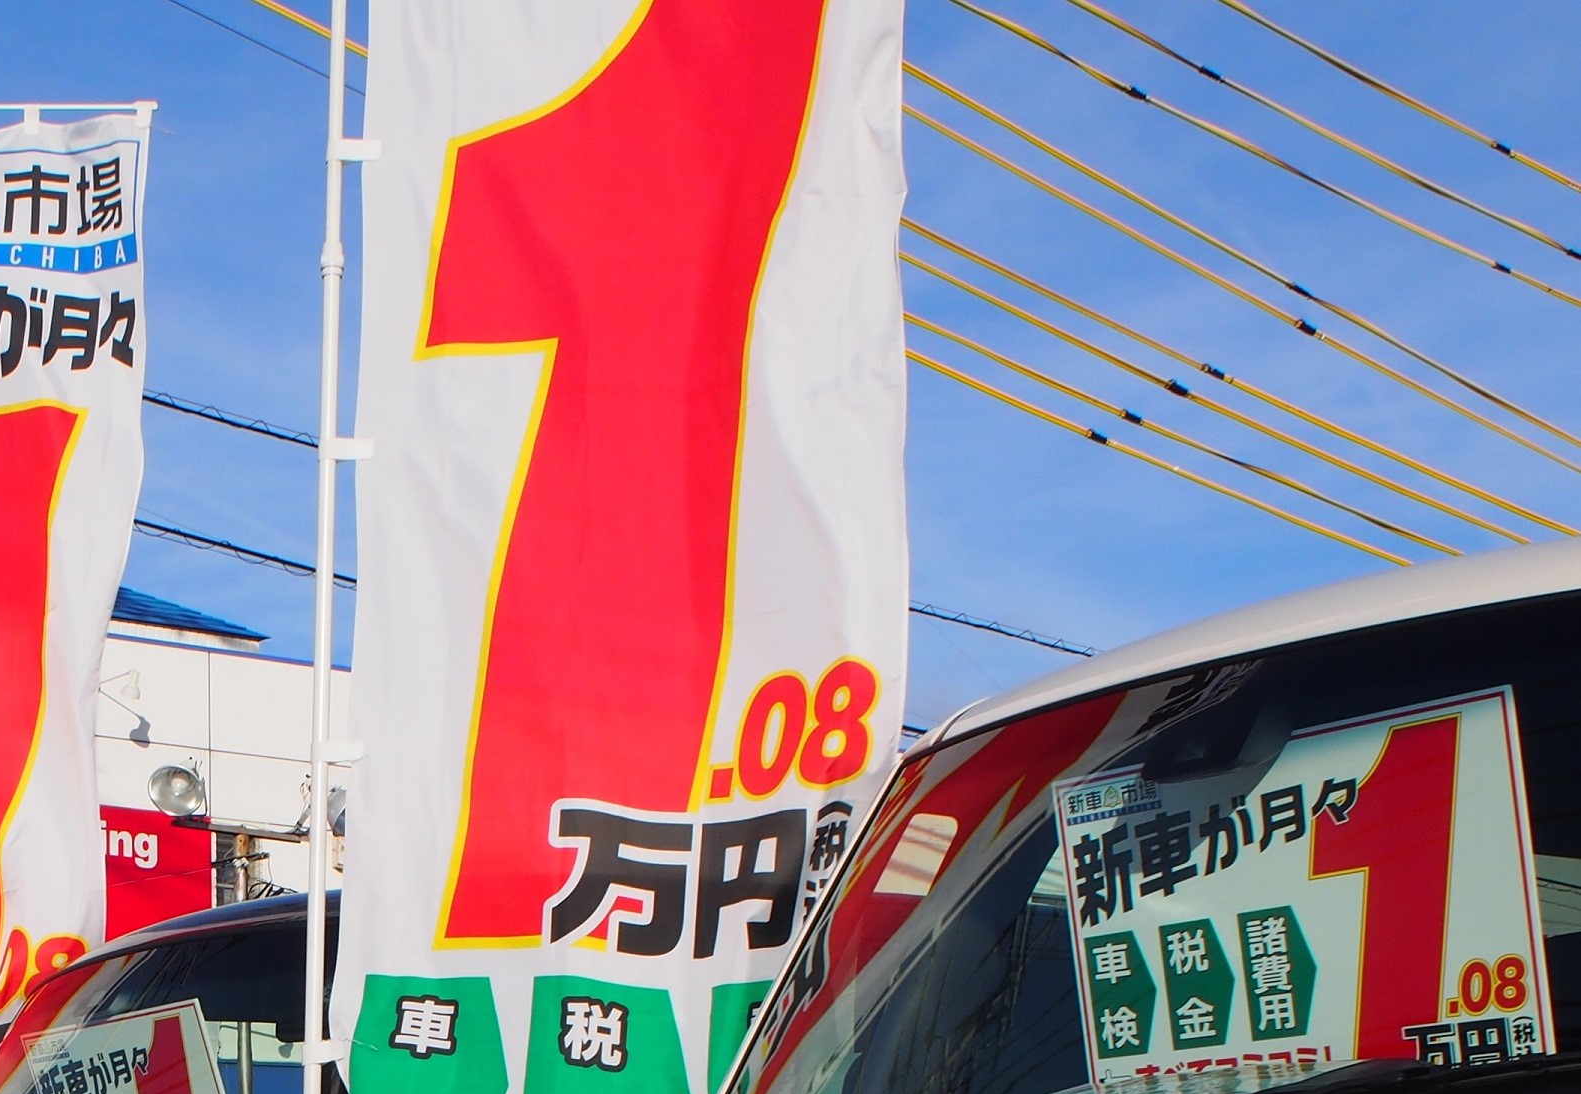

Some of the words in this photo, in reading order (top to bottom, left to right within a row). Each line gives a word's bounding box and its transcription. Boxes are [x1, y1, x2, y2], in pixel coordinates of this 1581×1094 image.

[3, 156, 122, 236] 市場
[414, 0, 827, 950] 1
[709, 656, 881, 803] .08
[549, 808, 807, 960] 万円
[1071, 776, 1361, 929] 新車が月々
[1308, 711, 1462, 1059] 1
[1091, 942, 1141, 1051] 車検
[1166, 928, 1217, 1041] 税金
[1245, 917, 1298, 1032] 諸費用
[1447, 953, 1528, 1018] .08
